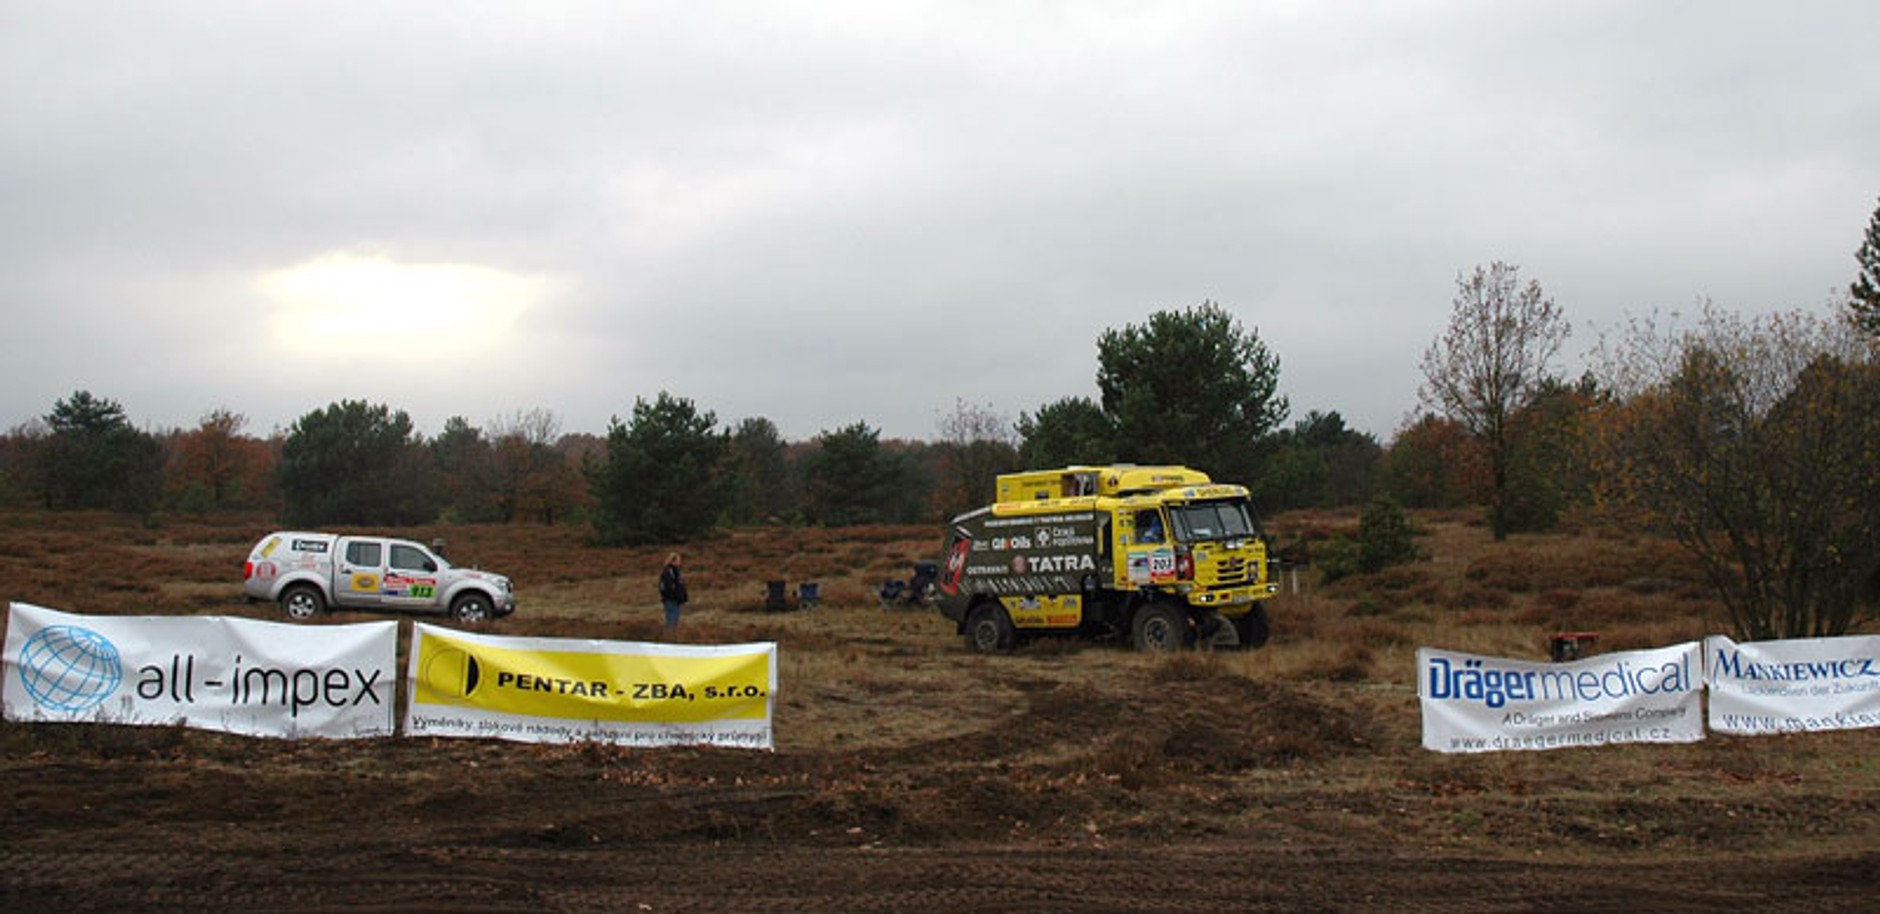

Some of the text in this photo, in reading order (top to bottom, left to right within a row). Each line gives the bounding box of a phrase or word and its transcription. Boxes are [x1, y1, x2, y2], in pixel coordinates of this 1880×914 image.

[1028, 554, 1095, 573] TATRA
[497, 671, 608, 698] PENTAR
[704, 683, 766, 699] s.r.o.
